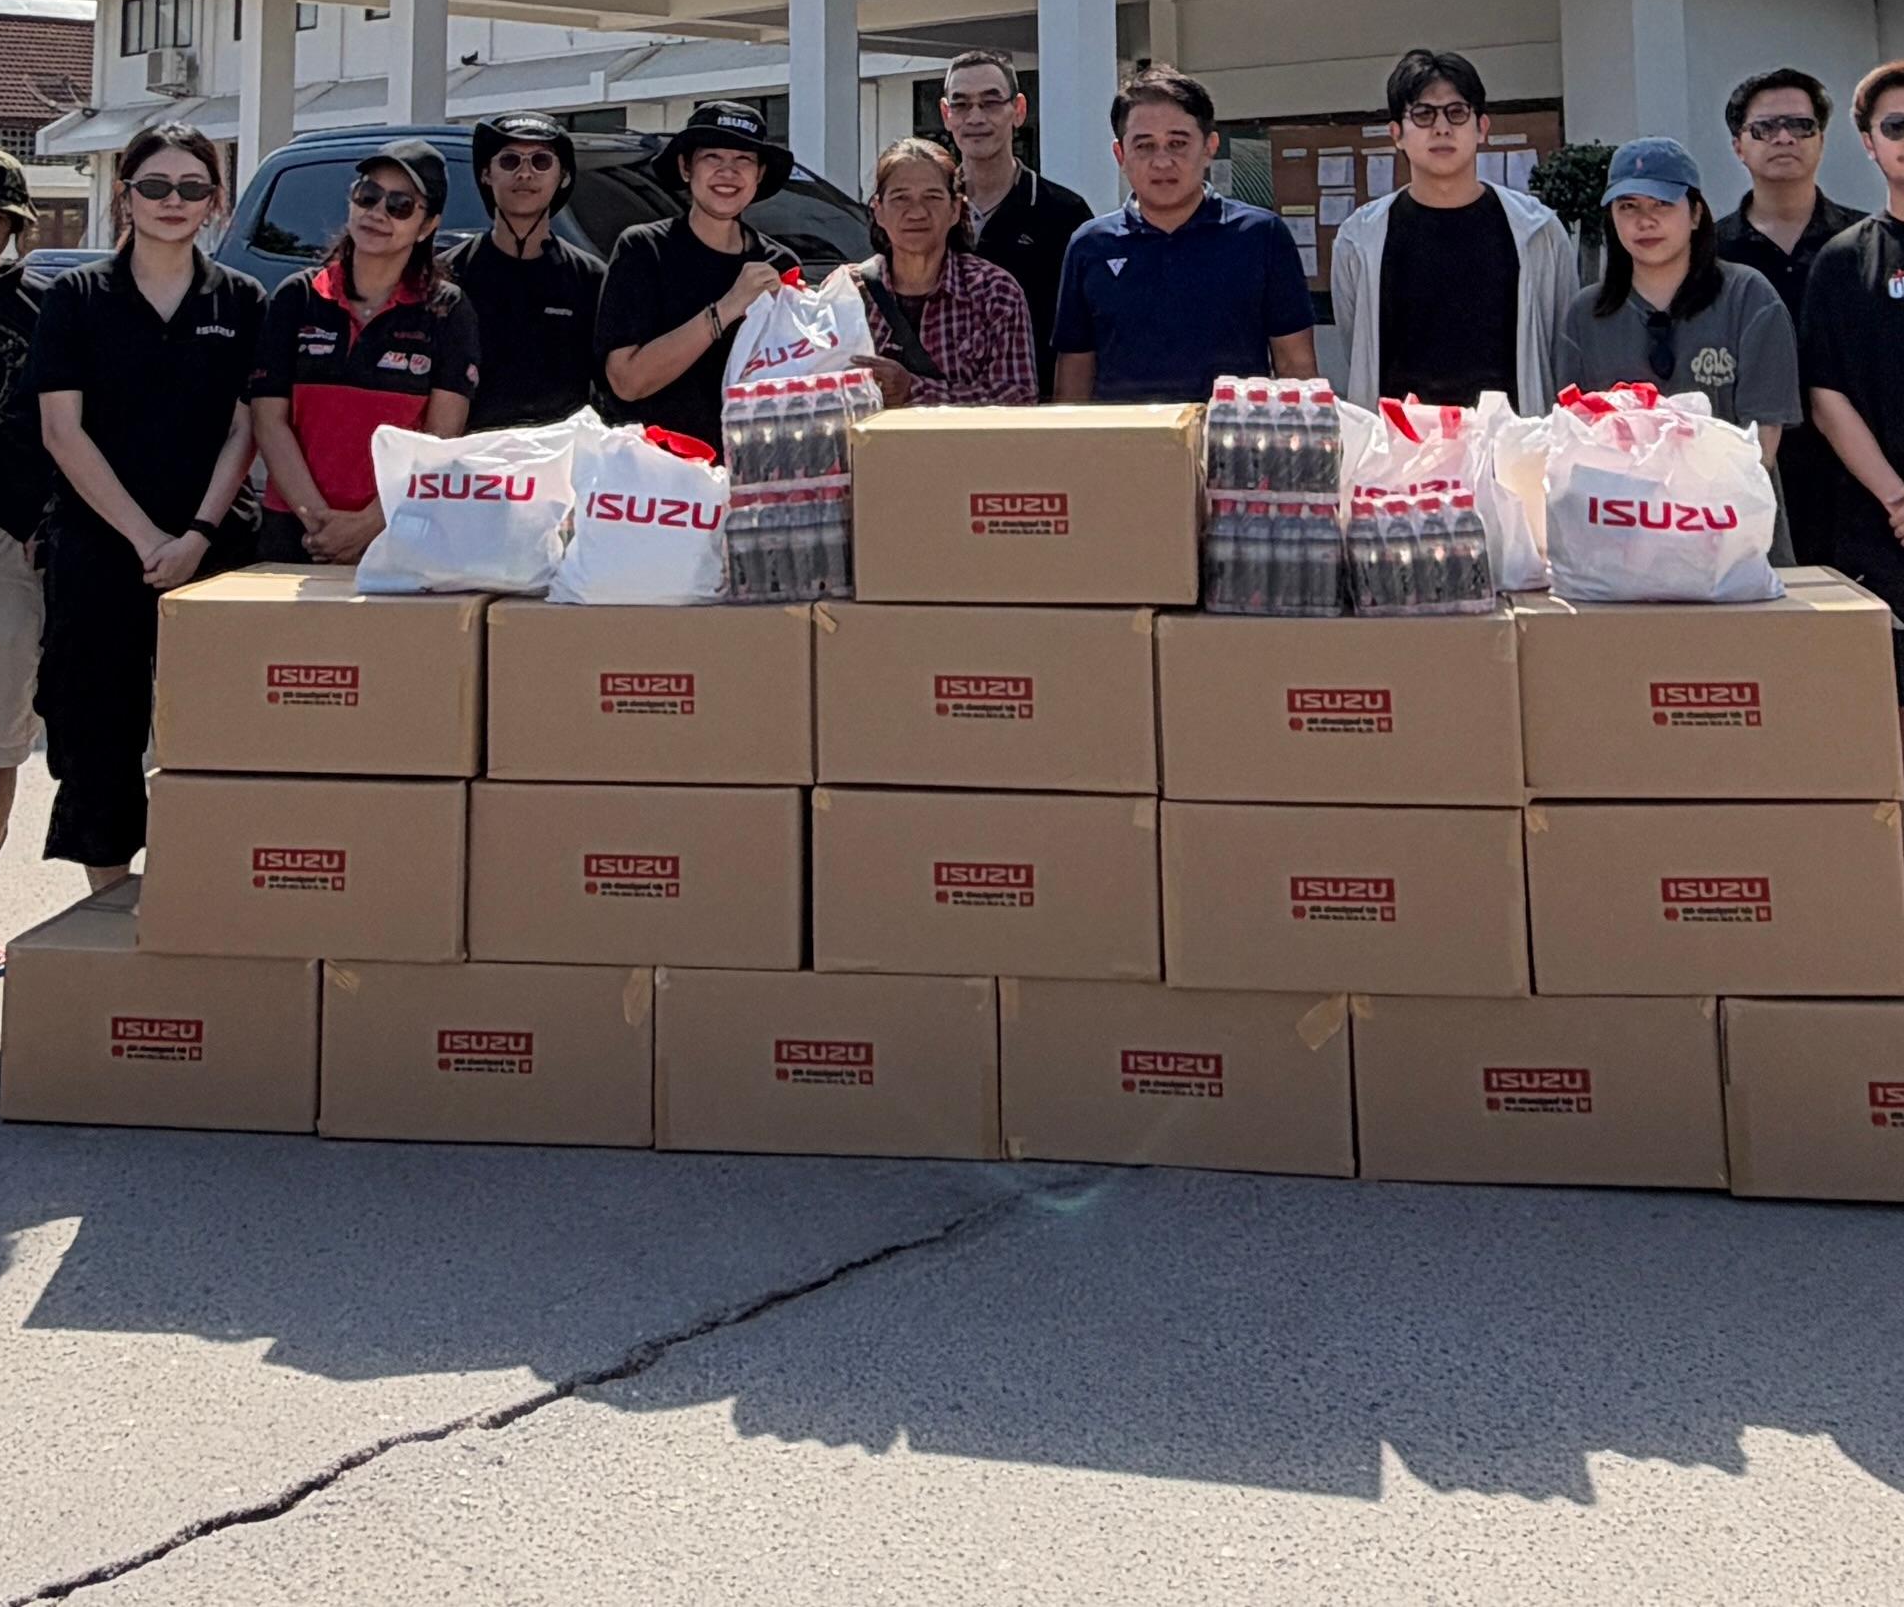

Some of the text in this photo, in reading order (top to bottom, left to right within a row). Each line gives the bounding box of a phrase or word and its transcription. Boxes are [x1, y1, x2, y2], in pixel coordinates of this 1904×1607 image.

[407, 474, 535, 502] ISUZU
[587, 492, 722, 530] ISUZU
[976, 497, 1062, 513] ISUZU
[1588, 496, 1738, 531] ISUZU
[273, 669, 353, 686] ISUZU
[606, 677, 689, 694] ISUZU
[941, 679, 1027, 697] ISUZU
[1656, 686, 1755, 704] ISUZU
[1293, 693, 1386, 710] ISUZU
[259, 852, 340, 870] ISUZU
[590, 858, 673, 877] ISUZU
[940, 866, 1028, 885] ISUZU
[1297, 880, 1390, 900] ISUZU
[1667, 881, 1766, 901] ISUZU
[118, 1021, 197, 1040] ISUZU
[444, 1034, 527, 1053] ISUZU
[781, 1044, 867, 1063] ISUZU
[1127, 1054, 1217, 1075] ISUZU
[1489, 1072, 1585, 1091] ISUZU
